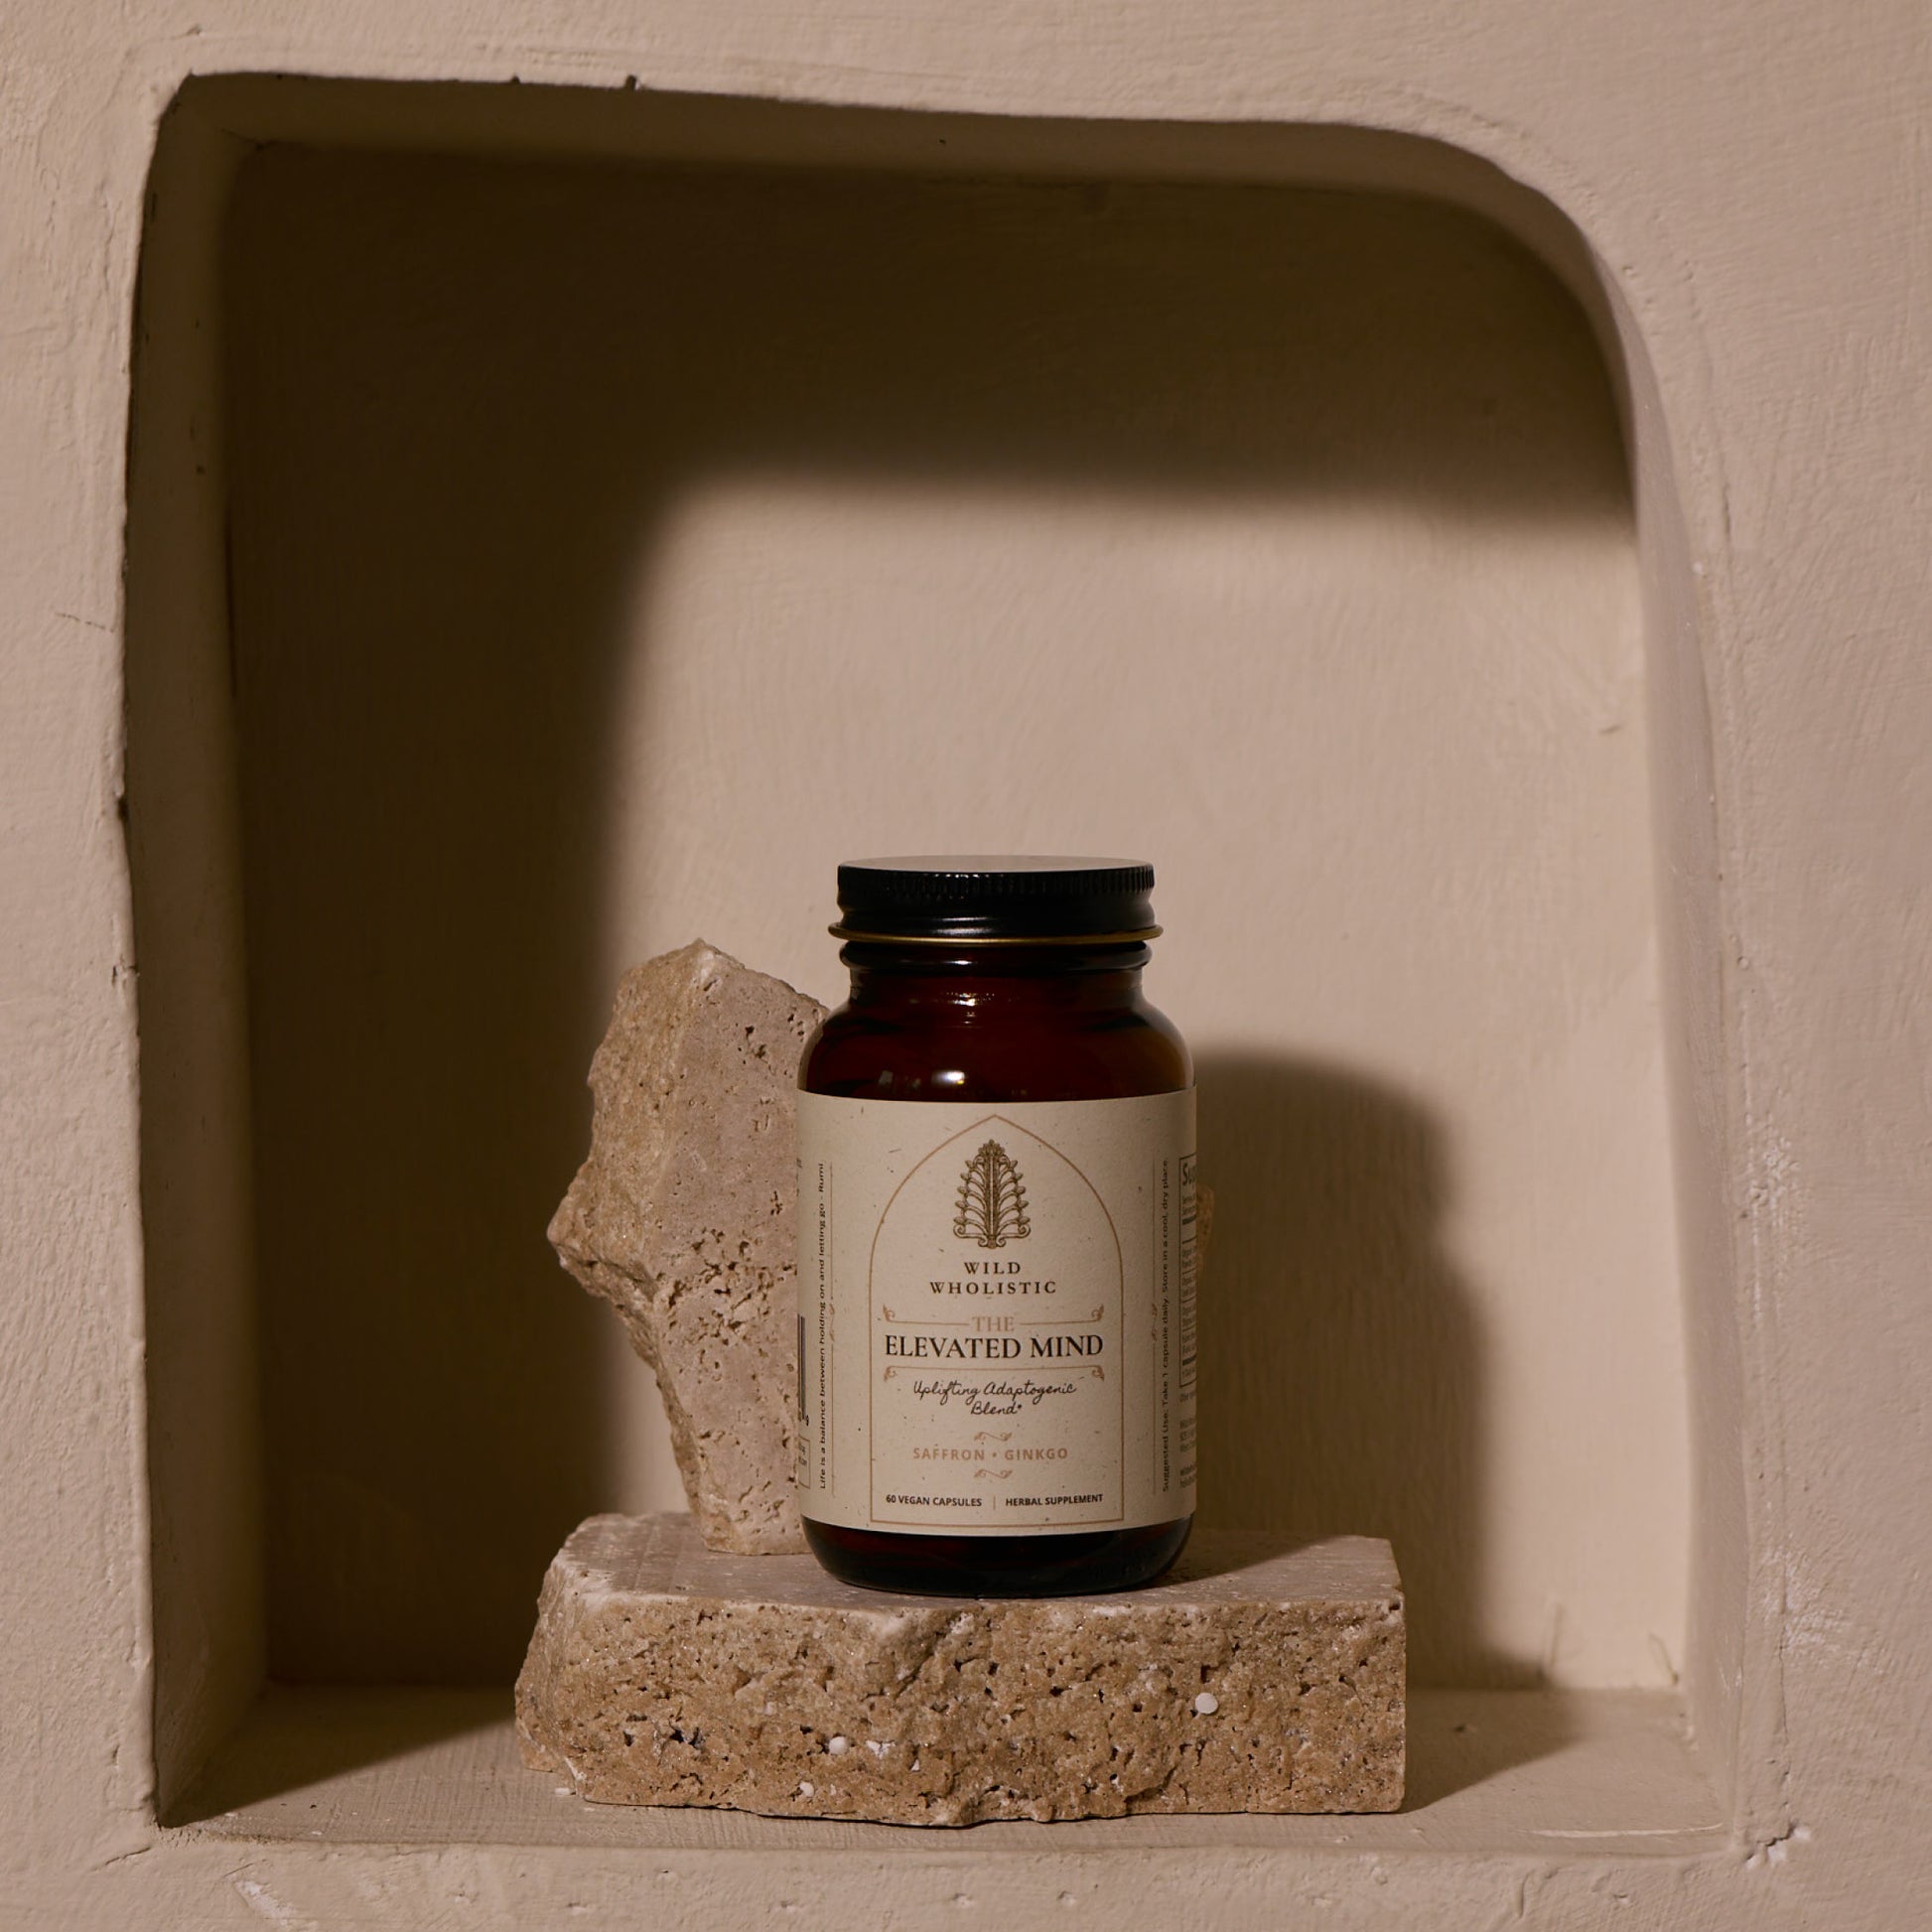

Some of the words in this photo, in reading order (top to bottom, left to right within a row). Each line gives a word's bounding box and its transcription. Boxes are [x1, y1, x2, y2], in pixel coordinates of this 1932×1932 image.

[819, 1202, 826, 1218] go
[964, 1262, 1021, 1275] WILD
[819, 1284, 825, 1300] on
[930, 1281, 1056, 1295] WHOLISTIC
[972, 1316, 1015, 1332] THE
[885, 1334, 1021, 1359] ELEVATED
[1031, 1334, 1103, 1358] MIND
[913, 1381, 980, 1405] Uplifting
[983, 1381, 1076, 1405] Adaptogenic
[912, 1448, 986, 1461] SAFFRON
[1004, 1448, 1069, 1461] GINKGO
[886, 1494, 897, 1504] 60
[897, 1495, 930, 1506] VEGAN
[932, 1496, 983, 1507] CAPSULES
[1005, 1496, 1043, 1506] HERBAL
[1044, 1493, 1104, 1506] SUPPLEMENT
